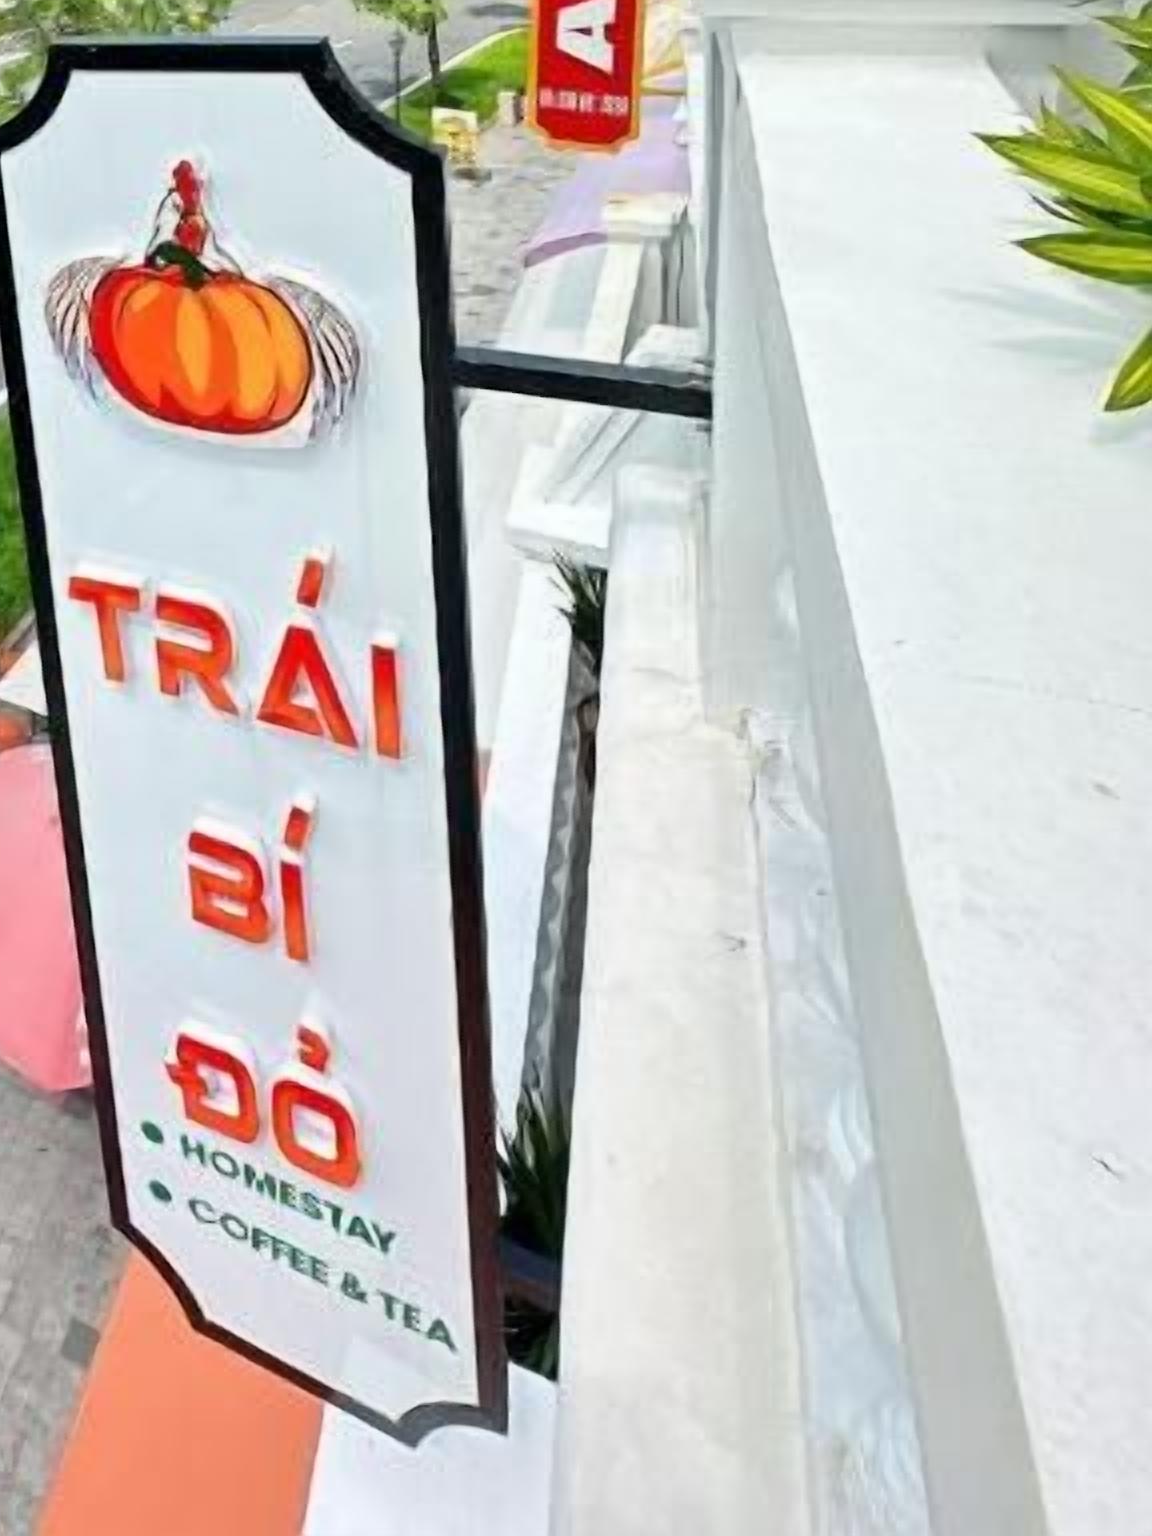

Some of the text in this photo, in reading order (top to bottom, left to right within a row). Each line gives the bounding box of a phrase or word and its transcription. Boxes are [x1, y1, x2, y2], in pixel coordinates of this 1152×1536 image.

[67, 554, 401, 760] TRÁI
[187, 804, 311, 964] BÍ
[165, 1024, 362, 1190] ĐỎ
[180, 1133, 397, 1256] HOMESTAY
[188, 1197, 458, 1356] COFFEE & TEA
